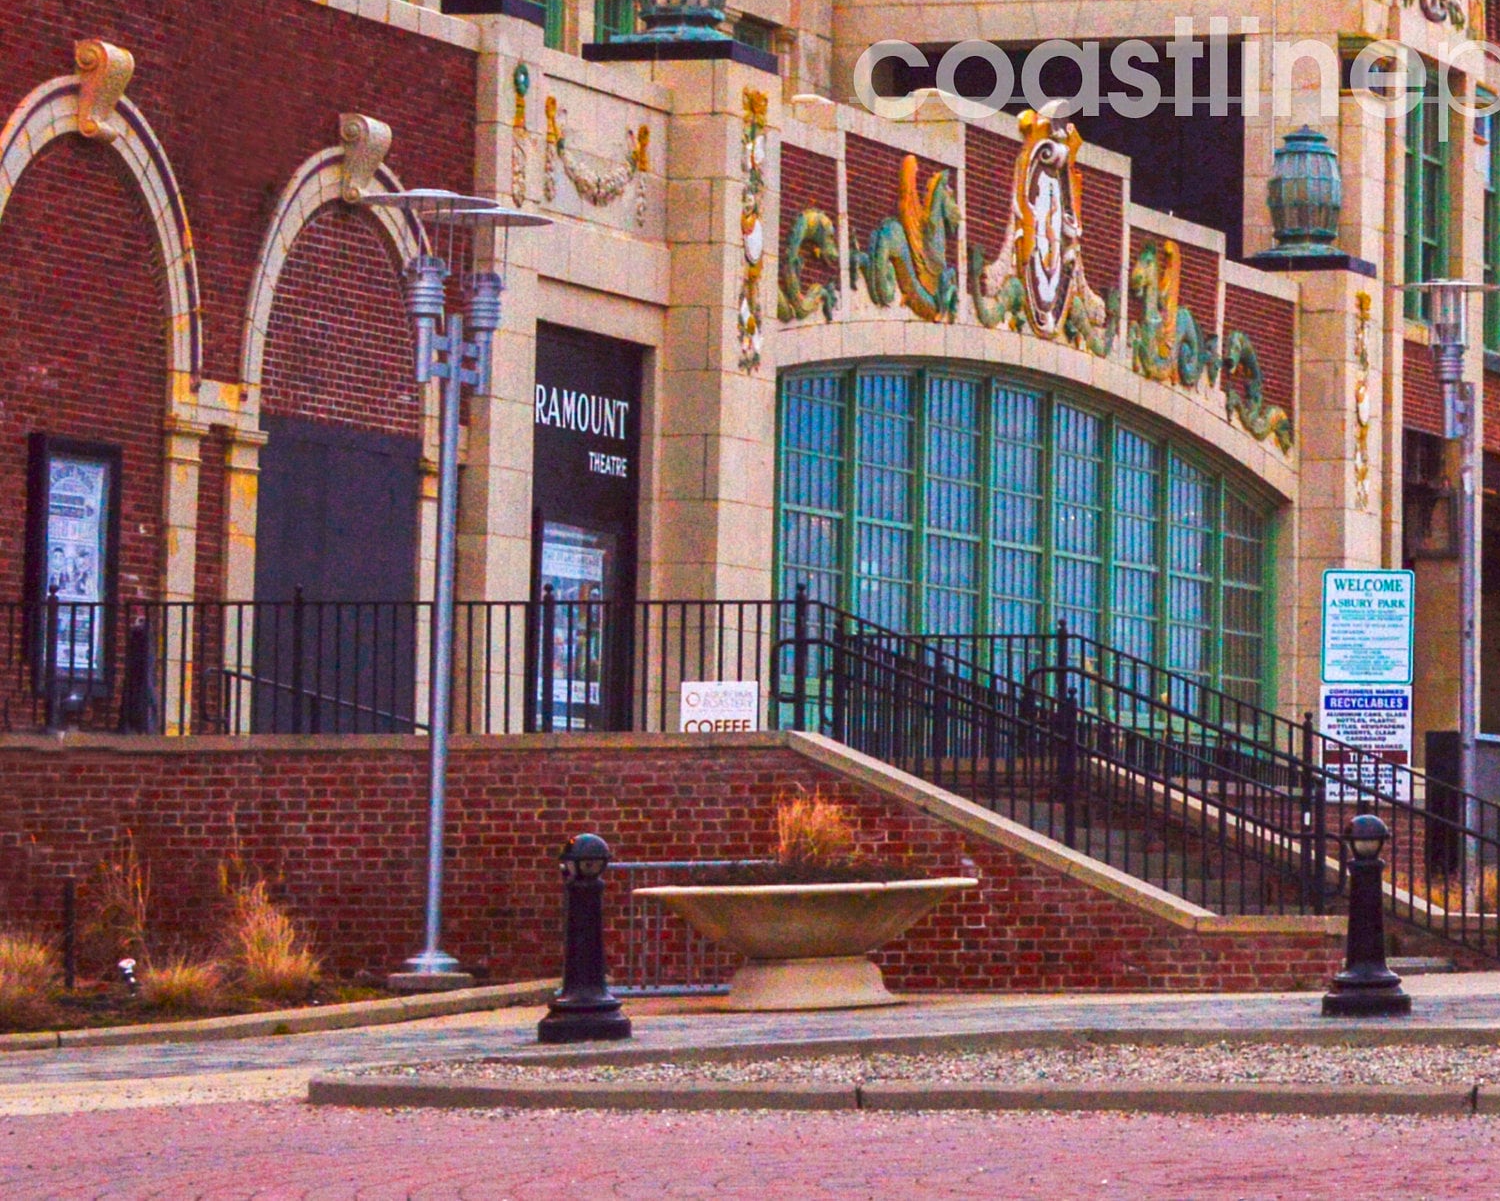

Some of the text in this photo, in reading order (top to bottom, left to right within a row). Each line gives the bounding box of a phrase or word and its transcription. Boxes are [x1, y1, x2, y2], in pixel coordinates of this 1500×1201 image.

[588, 451, 628, 478] THEATRE
[1334, 578, 1404, 592] WELCOME
[1330, 599, 1405, 609] ASBURY PARK
[1330, 697, 1403, 709] RECYCLABLES
